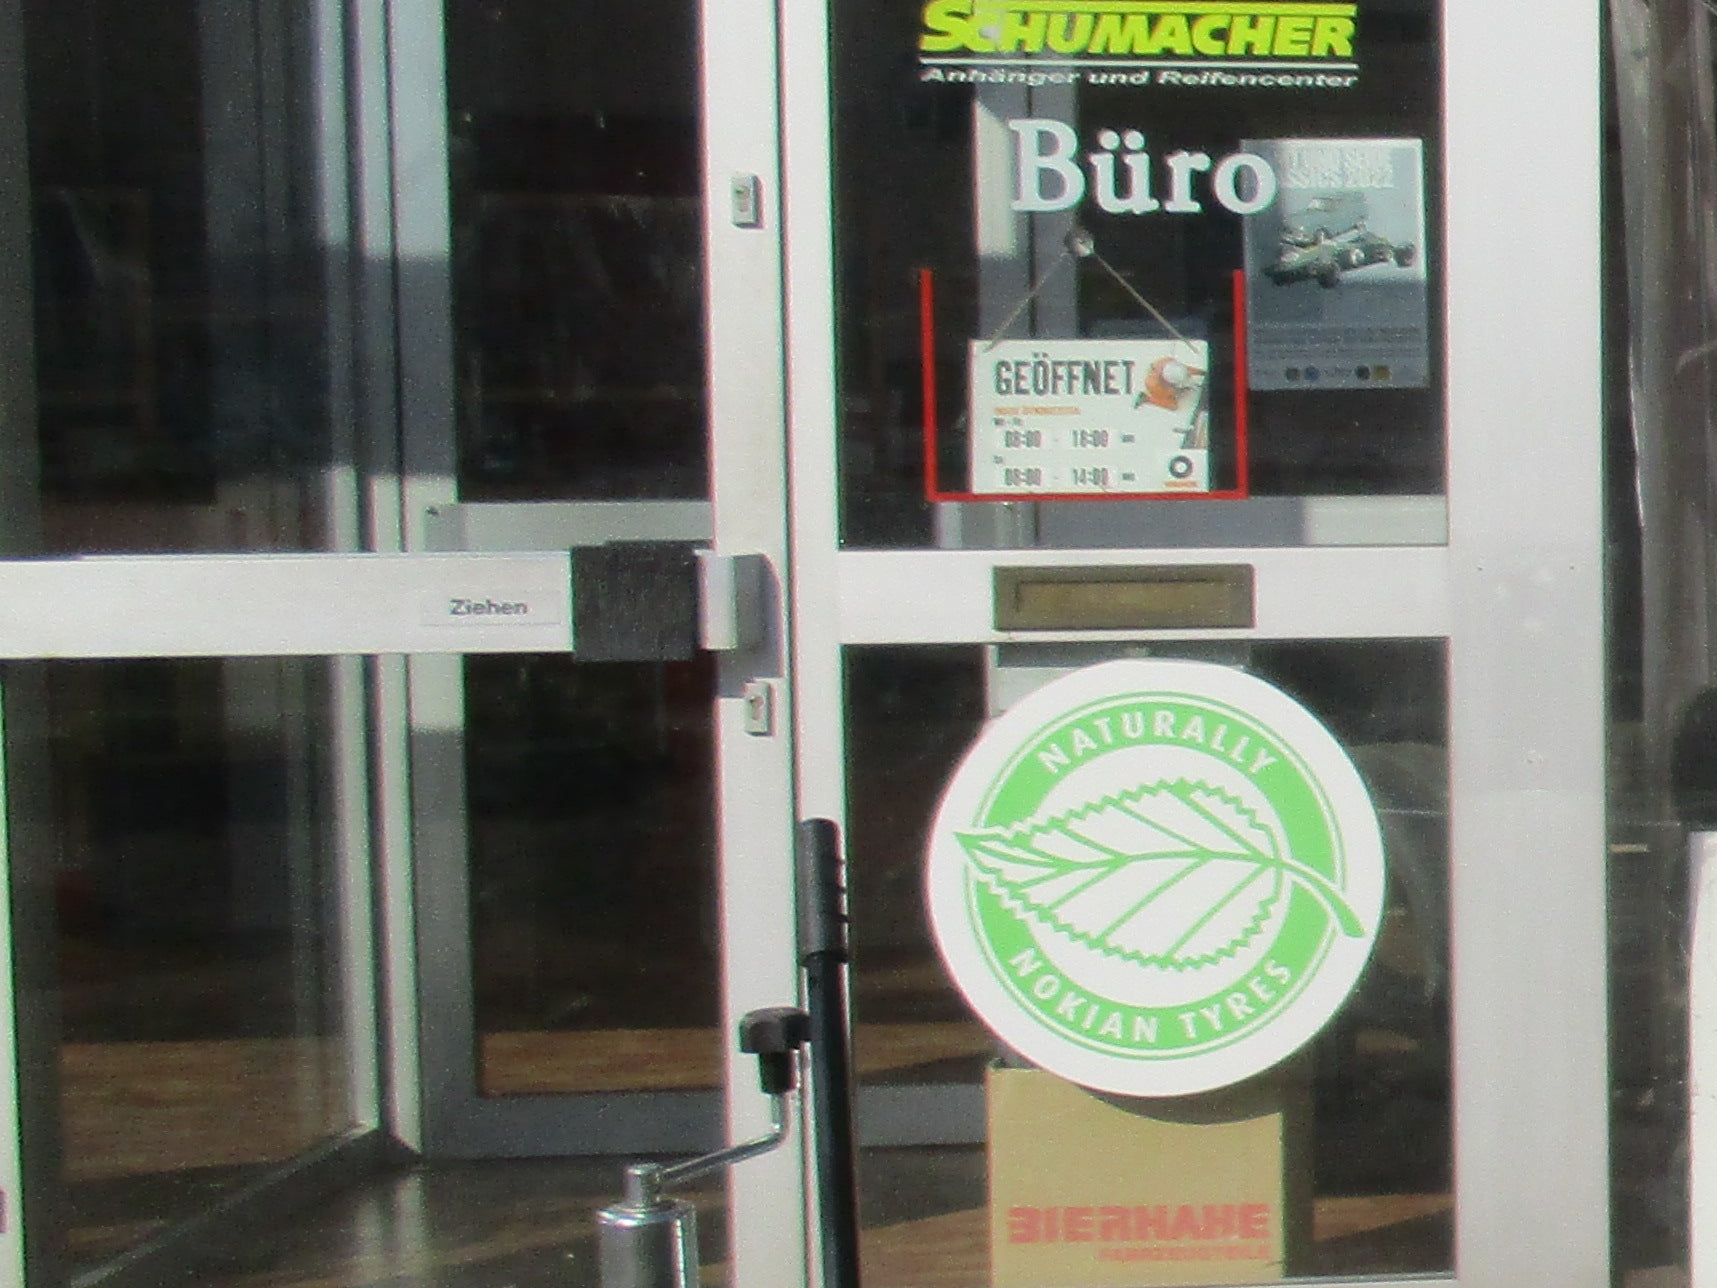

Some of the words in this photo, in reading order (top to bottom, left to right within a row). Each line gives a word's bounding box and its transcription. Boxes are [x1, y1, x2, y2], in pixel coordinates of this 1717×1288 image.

[921, 67, 1080, 86] Anhänger
[1088, 71, 1150, 86] und
[1156, 71, 1359, 88] Reifencenter
[1008, 118, 1278, 214] Büro
[994, 352, 1136, 397] GEÖFFNET
[450, 598, 529, 616] Ziehen
[1038, 710, 1277, 774] NATURALLY
[1009, 946, 1159, 1044] NOKIAN
[1178, 959, 1292, 1040] TYRES
